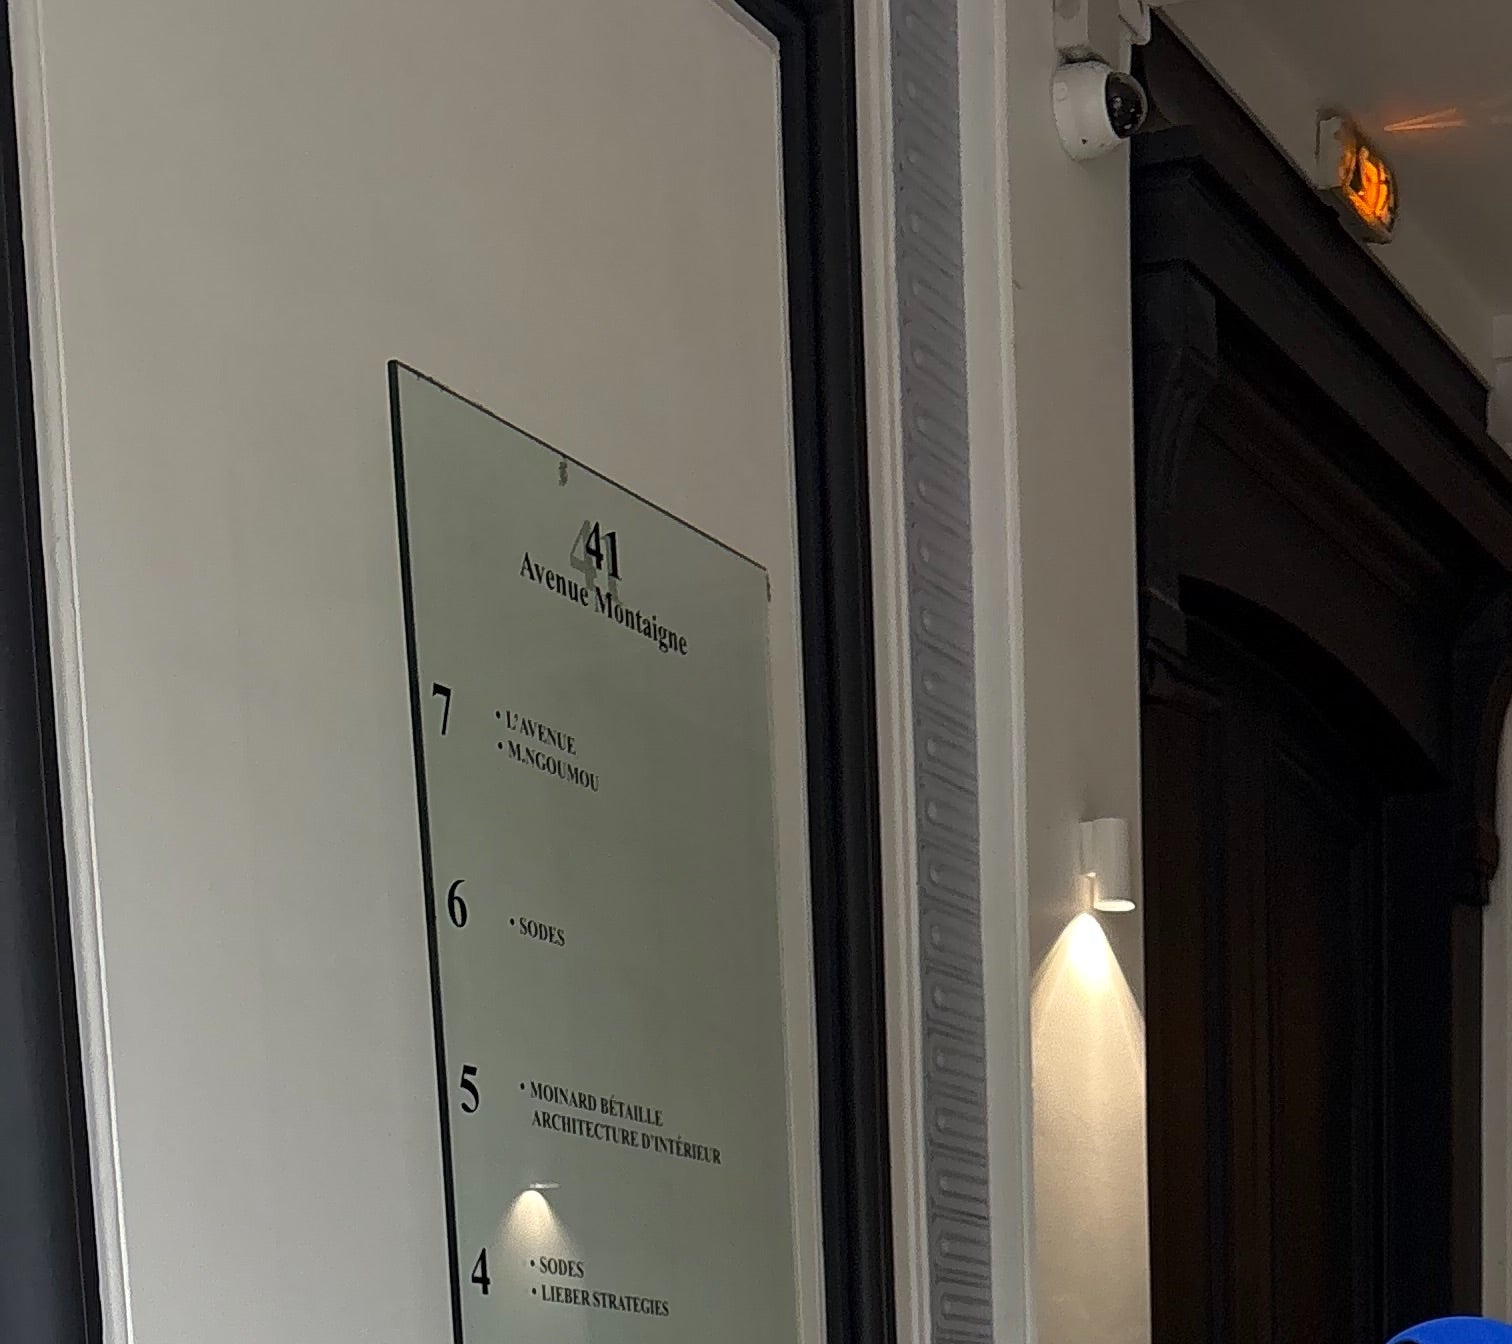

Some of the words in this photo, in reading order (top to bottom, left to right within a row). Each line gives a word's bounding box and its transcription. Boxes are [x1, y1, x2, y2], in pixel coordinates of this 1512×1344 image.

[585, 521, 622, 580] 41
[519, 551, 589, 607] Avenue
[594, 586, 689, 656] Montaigne
[432, 682, 452, 736] 7
[505, 710, 577, 756] L'AVENUE
[507, 739, 600, 793] M.NGOUMOU
[447, 879, 468, 928] 6
[518, 916, 566, 947] SODES
[459, 1064, 480, 1114] 5
[529, 1080, 598, 1112] MOINARD
[600, 1094, 664, 1128] BÉTAILLE
[531, 1109, 639, 1148] ARCHITECTURE
[641, 1134, 722, 1165] D'INTÉRIEUR
[471, 1247, 491, 1295] 4
[539, 1256, 585, 1279] SODES
[541, 1284, 592, 1307] LIEBER
[593, 1291, 670, 1318] STRATEGIES
